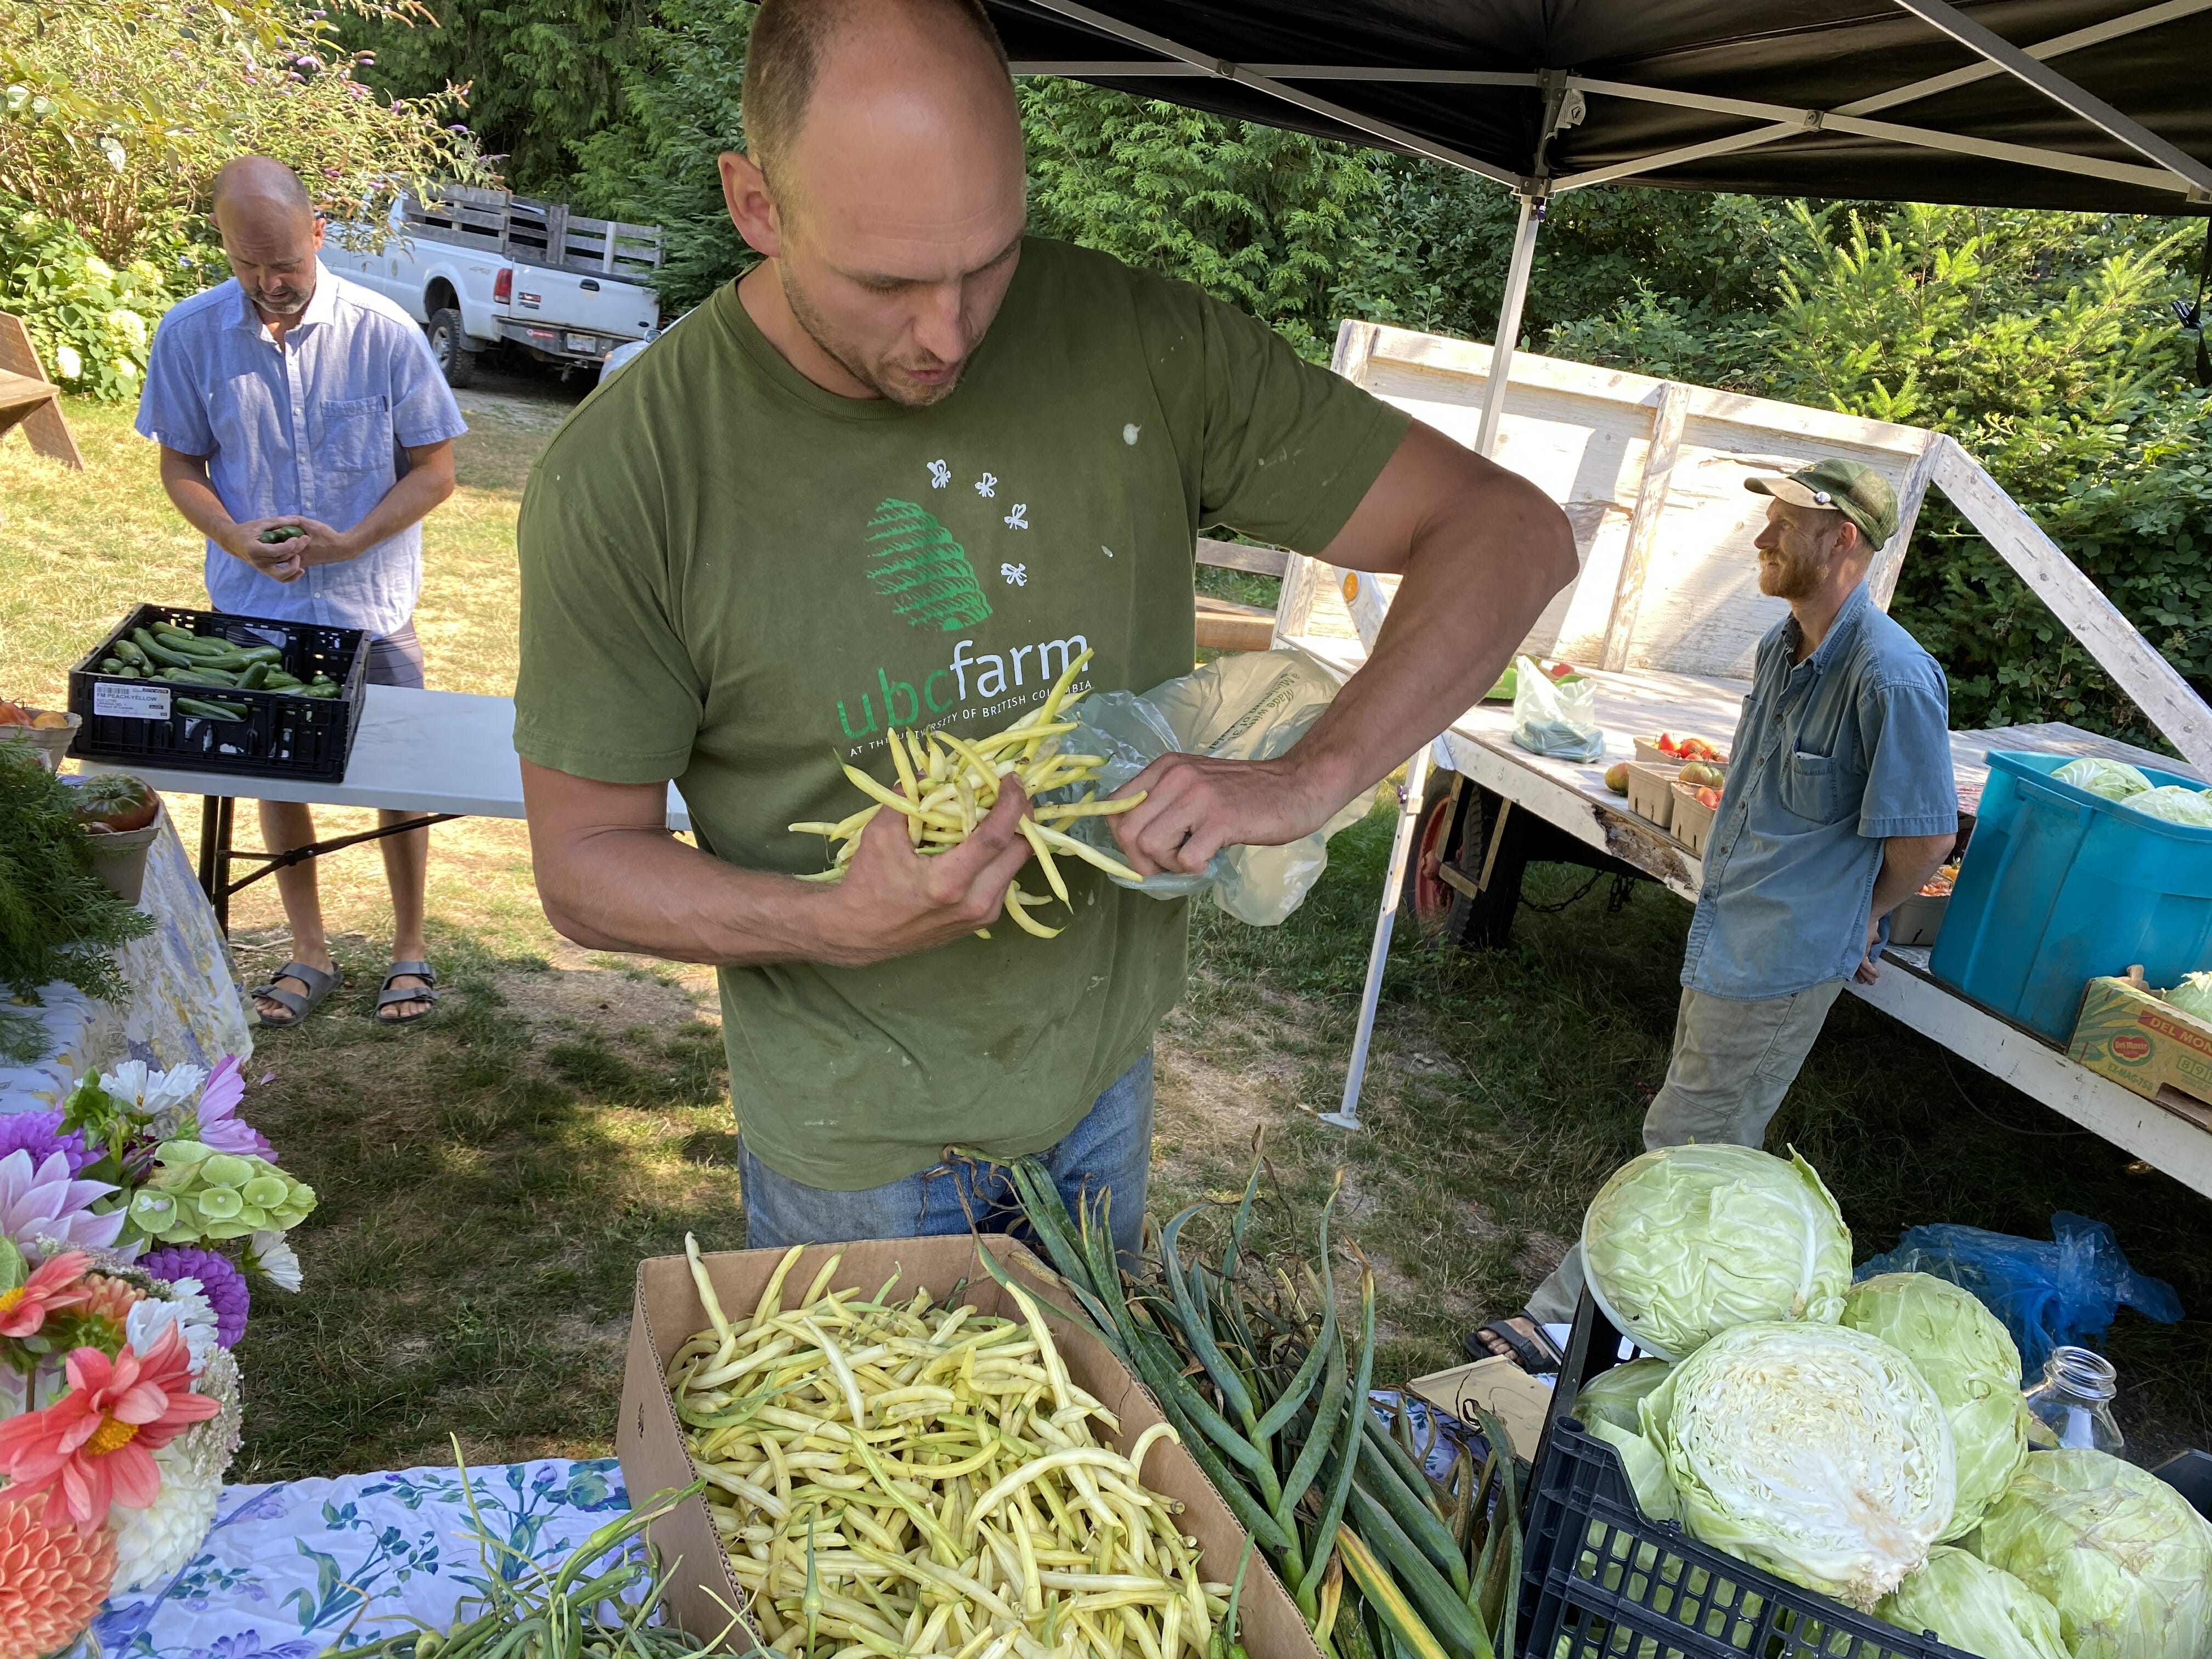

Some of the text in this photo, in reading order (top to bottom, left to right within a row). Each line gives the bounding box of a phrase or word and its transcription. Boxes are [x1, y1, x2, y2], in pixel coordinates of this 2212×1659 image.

[1266, 689, 1294, 708] Made
[850, 680, 1092, 757] AT THE UIVRSITY OF BRITISH COLBIA
[2150, 1017, 2176, 1037] DEL
[2115, 1041, 2147, 1049] Del Monte
[2181, 1060, 2190, 1069] 8
[2196, 1066, 2204, 1075] 9
